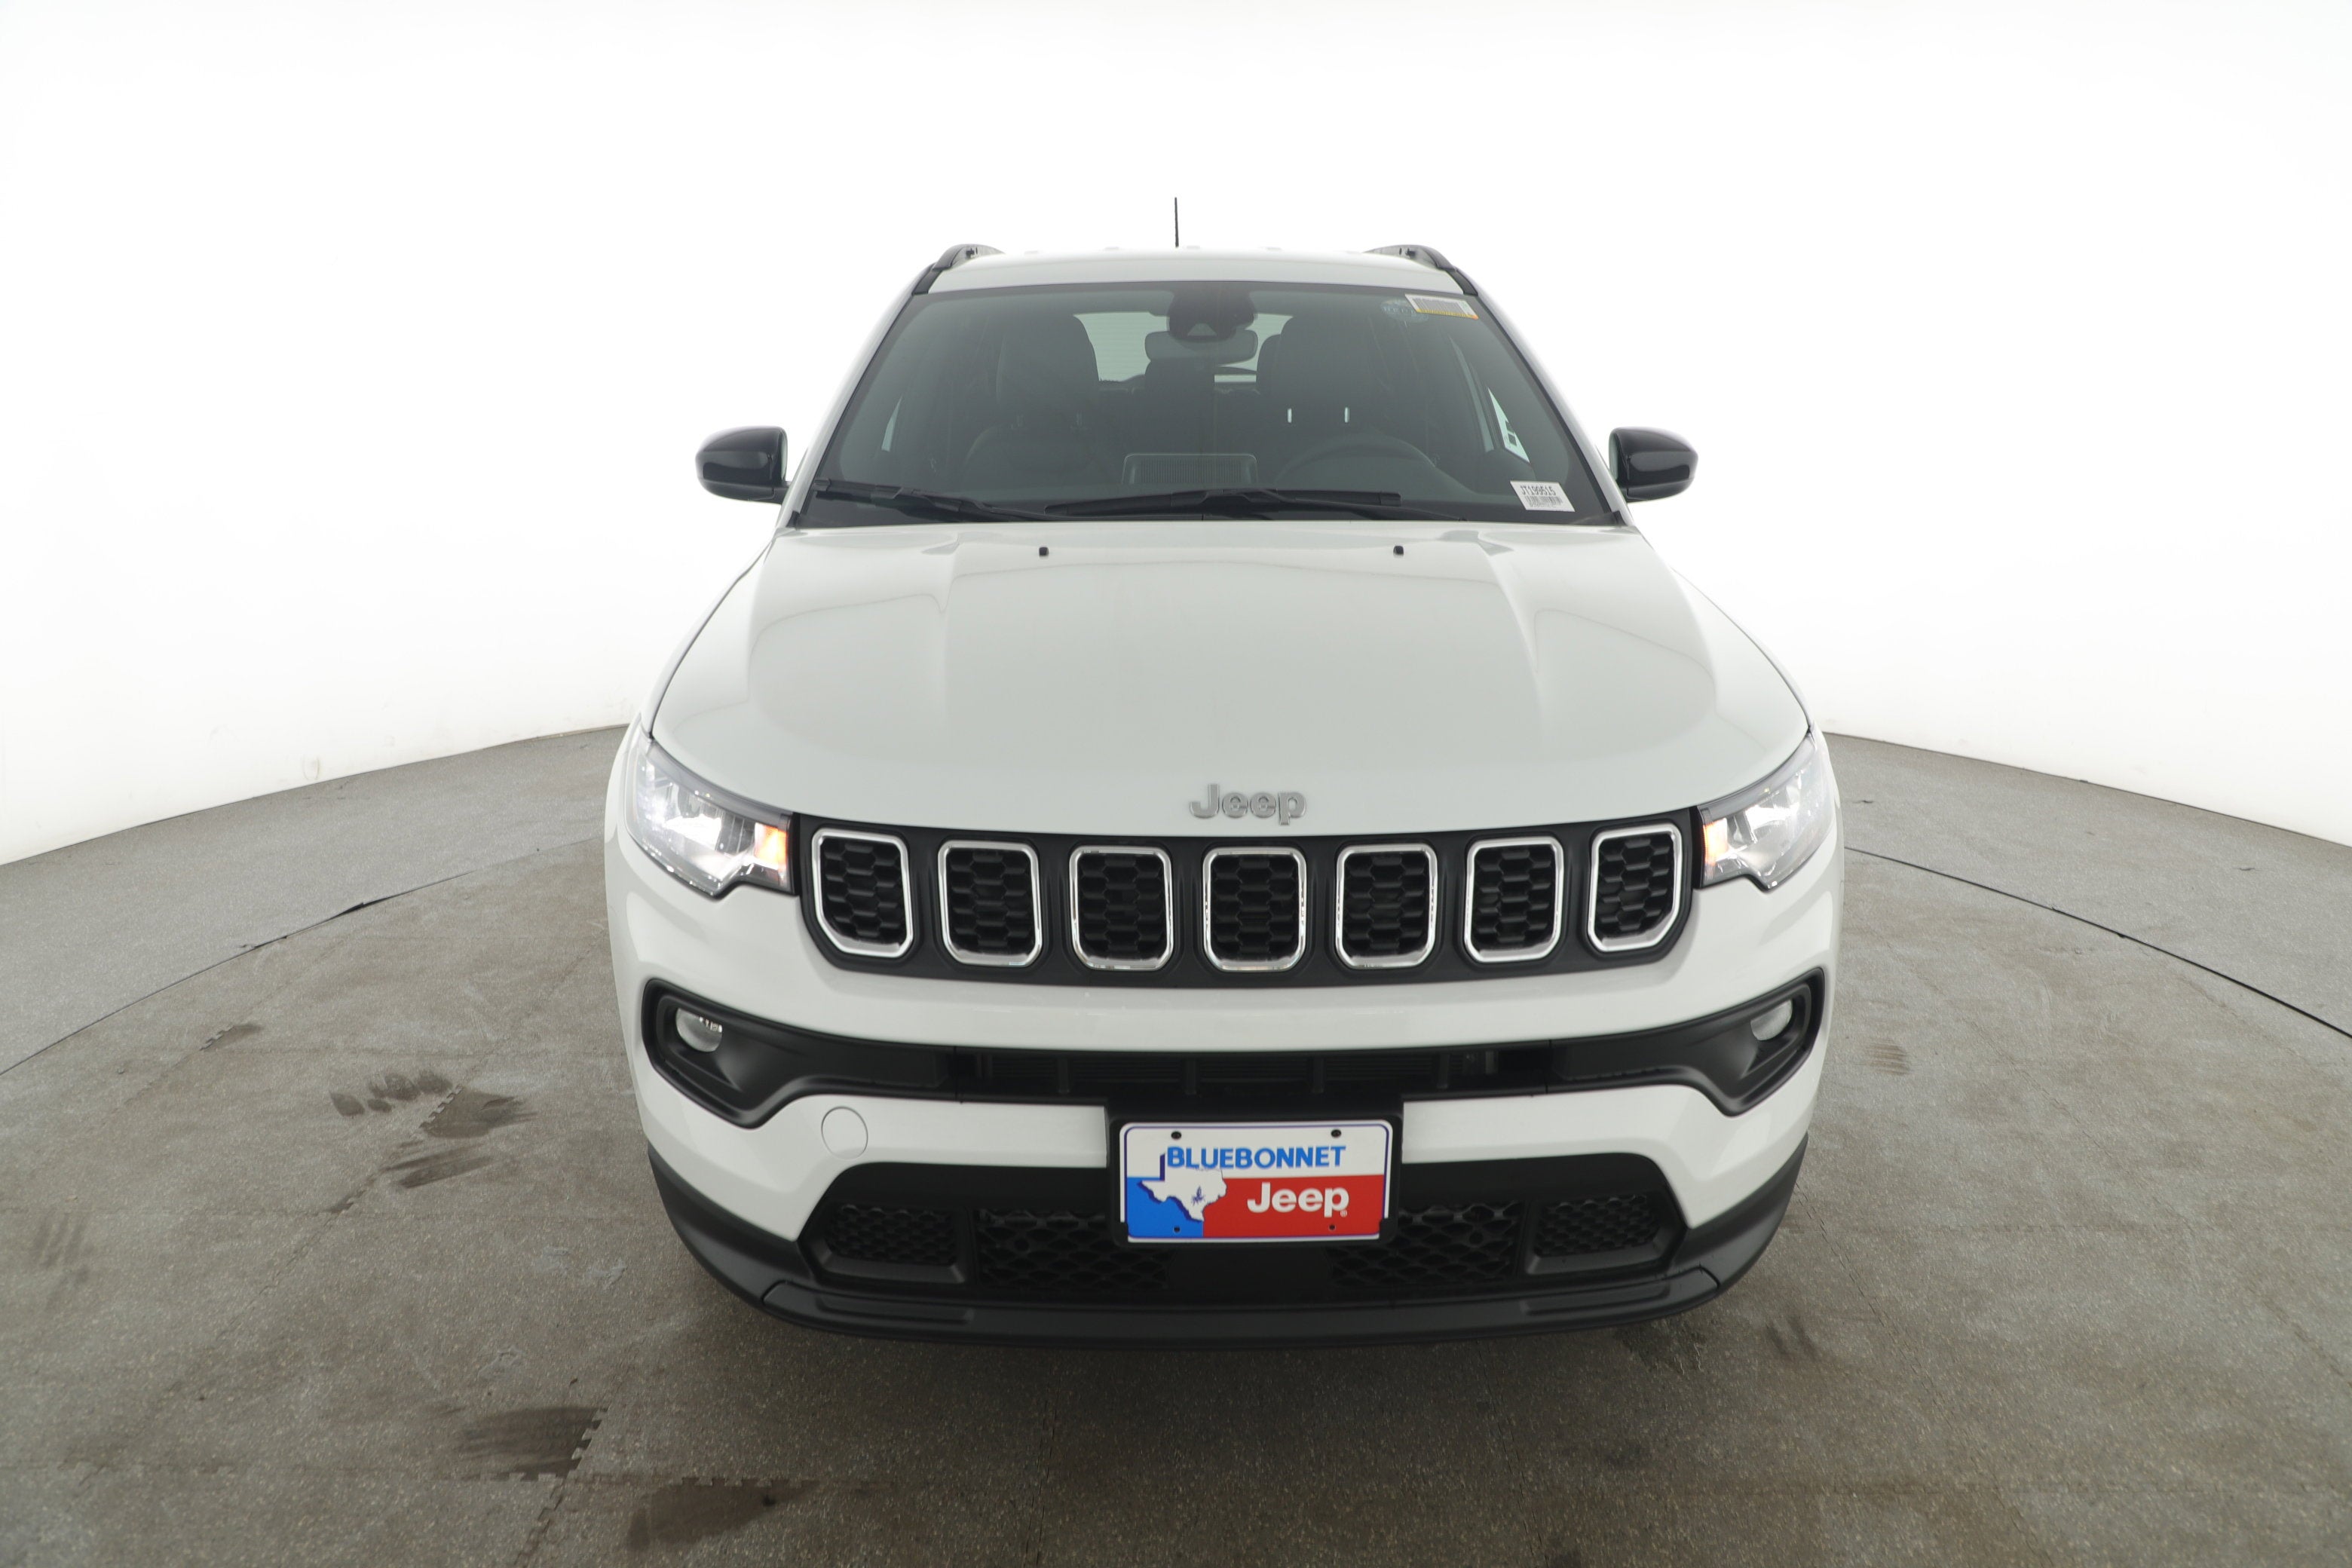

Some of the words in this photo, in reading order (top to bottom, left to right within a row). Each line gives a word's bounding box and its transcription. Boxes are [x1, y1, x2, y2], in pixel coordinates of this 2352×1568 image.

[1190, 783, 1306, 825] Jeep
[1167, 1146, 1346, 1168] BLUEBONNET
[1247, 1182, 1350, 1218] Jeep
